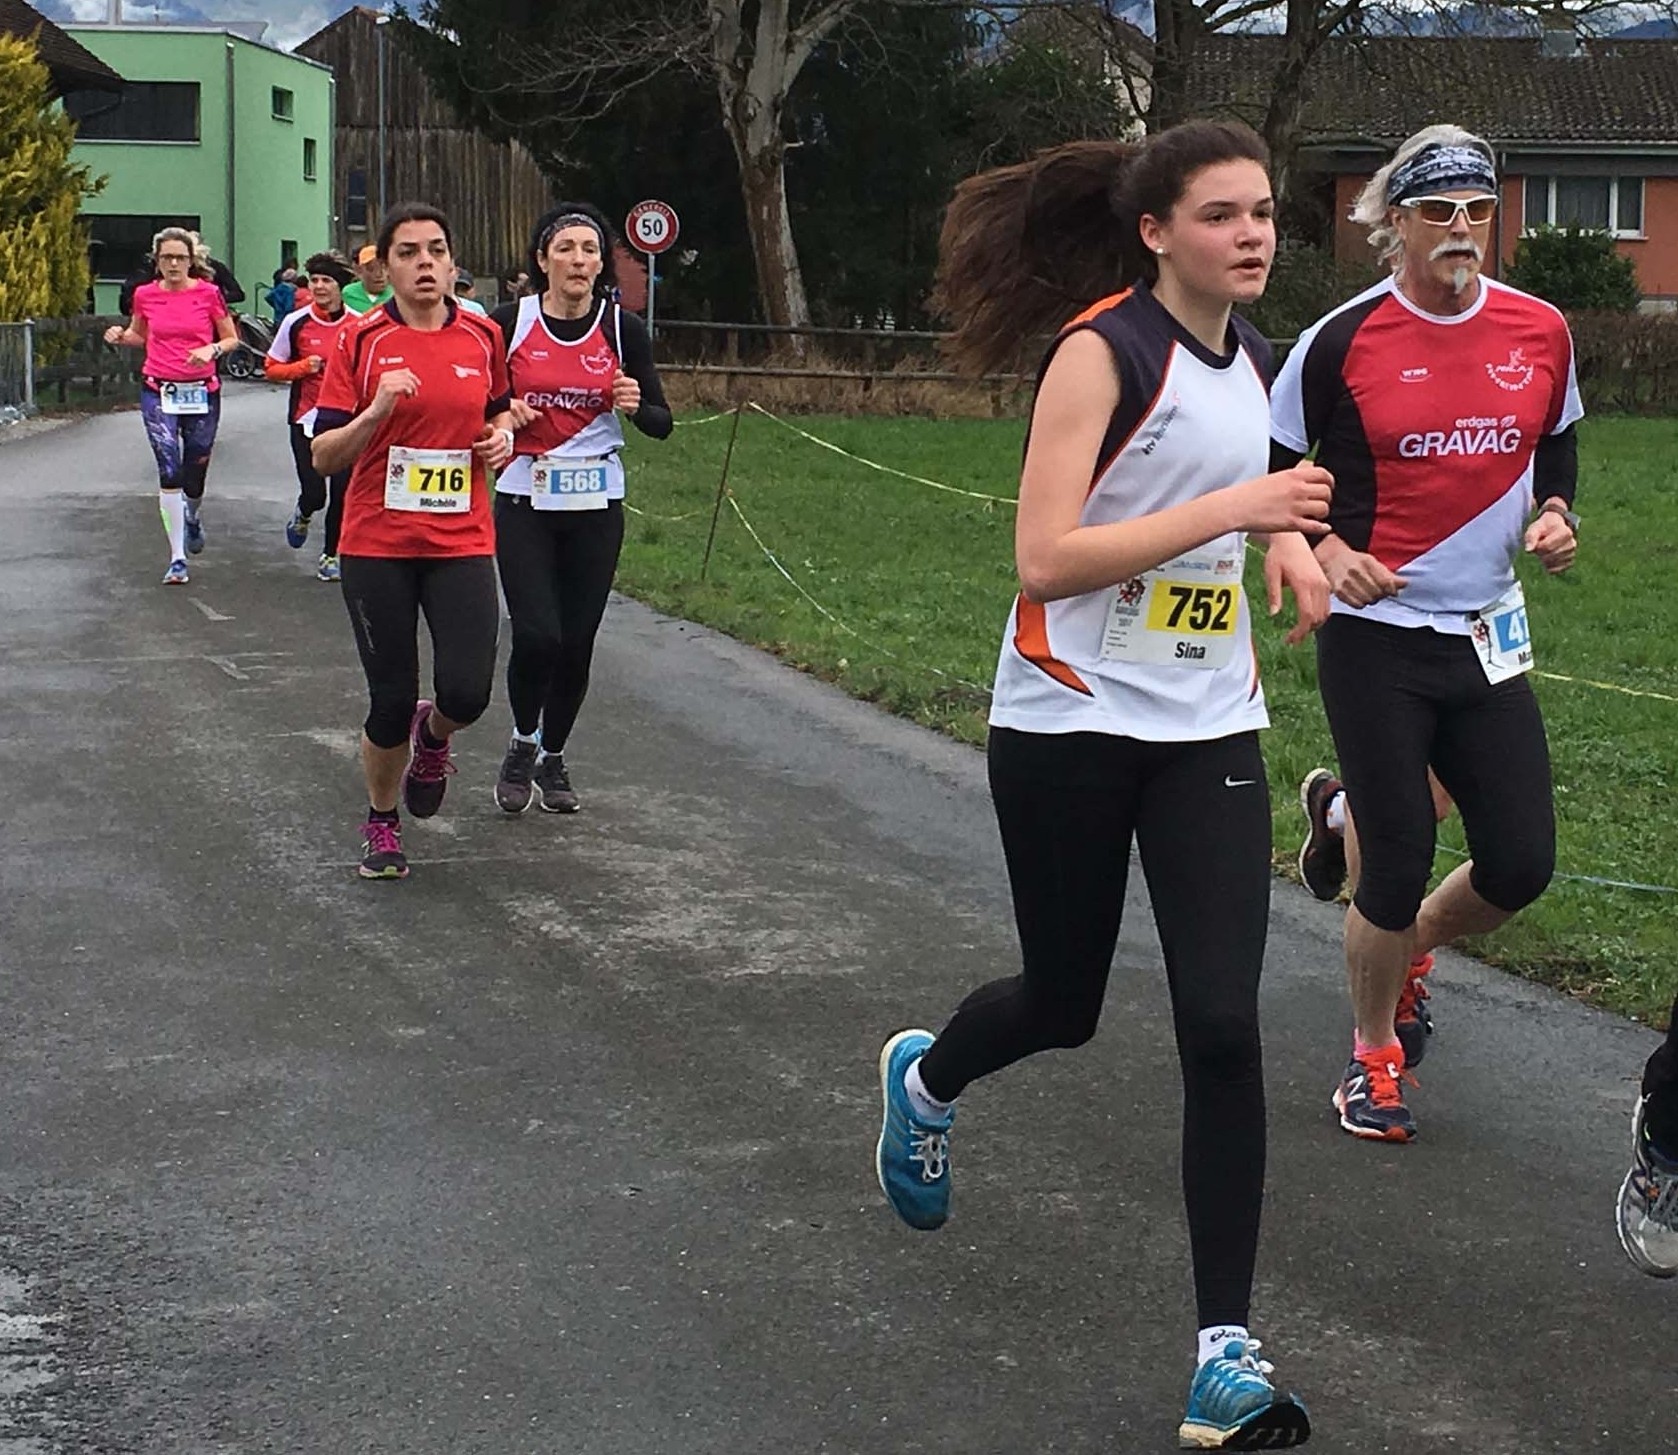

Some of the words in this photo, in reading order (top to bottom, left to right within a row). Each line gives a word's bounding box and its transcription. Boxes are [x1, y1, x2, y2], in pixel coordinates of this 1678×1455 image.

[642, 218, 663, 236] 50
[1455, 416, 1498, 428] erdgas
[1399, 428, 1521, 458] GRAVAG
[419, 468, 464, 492] 716
[559, 471, 601, 493] 568
[1167, 586, 1232, 631] 752
[1174, 641, 1206, 660] Sina
